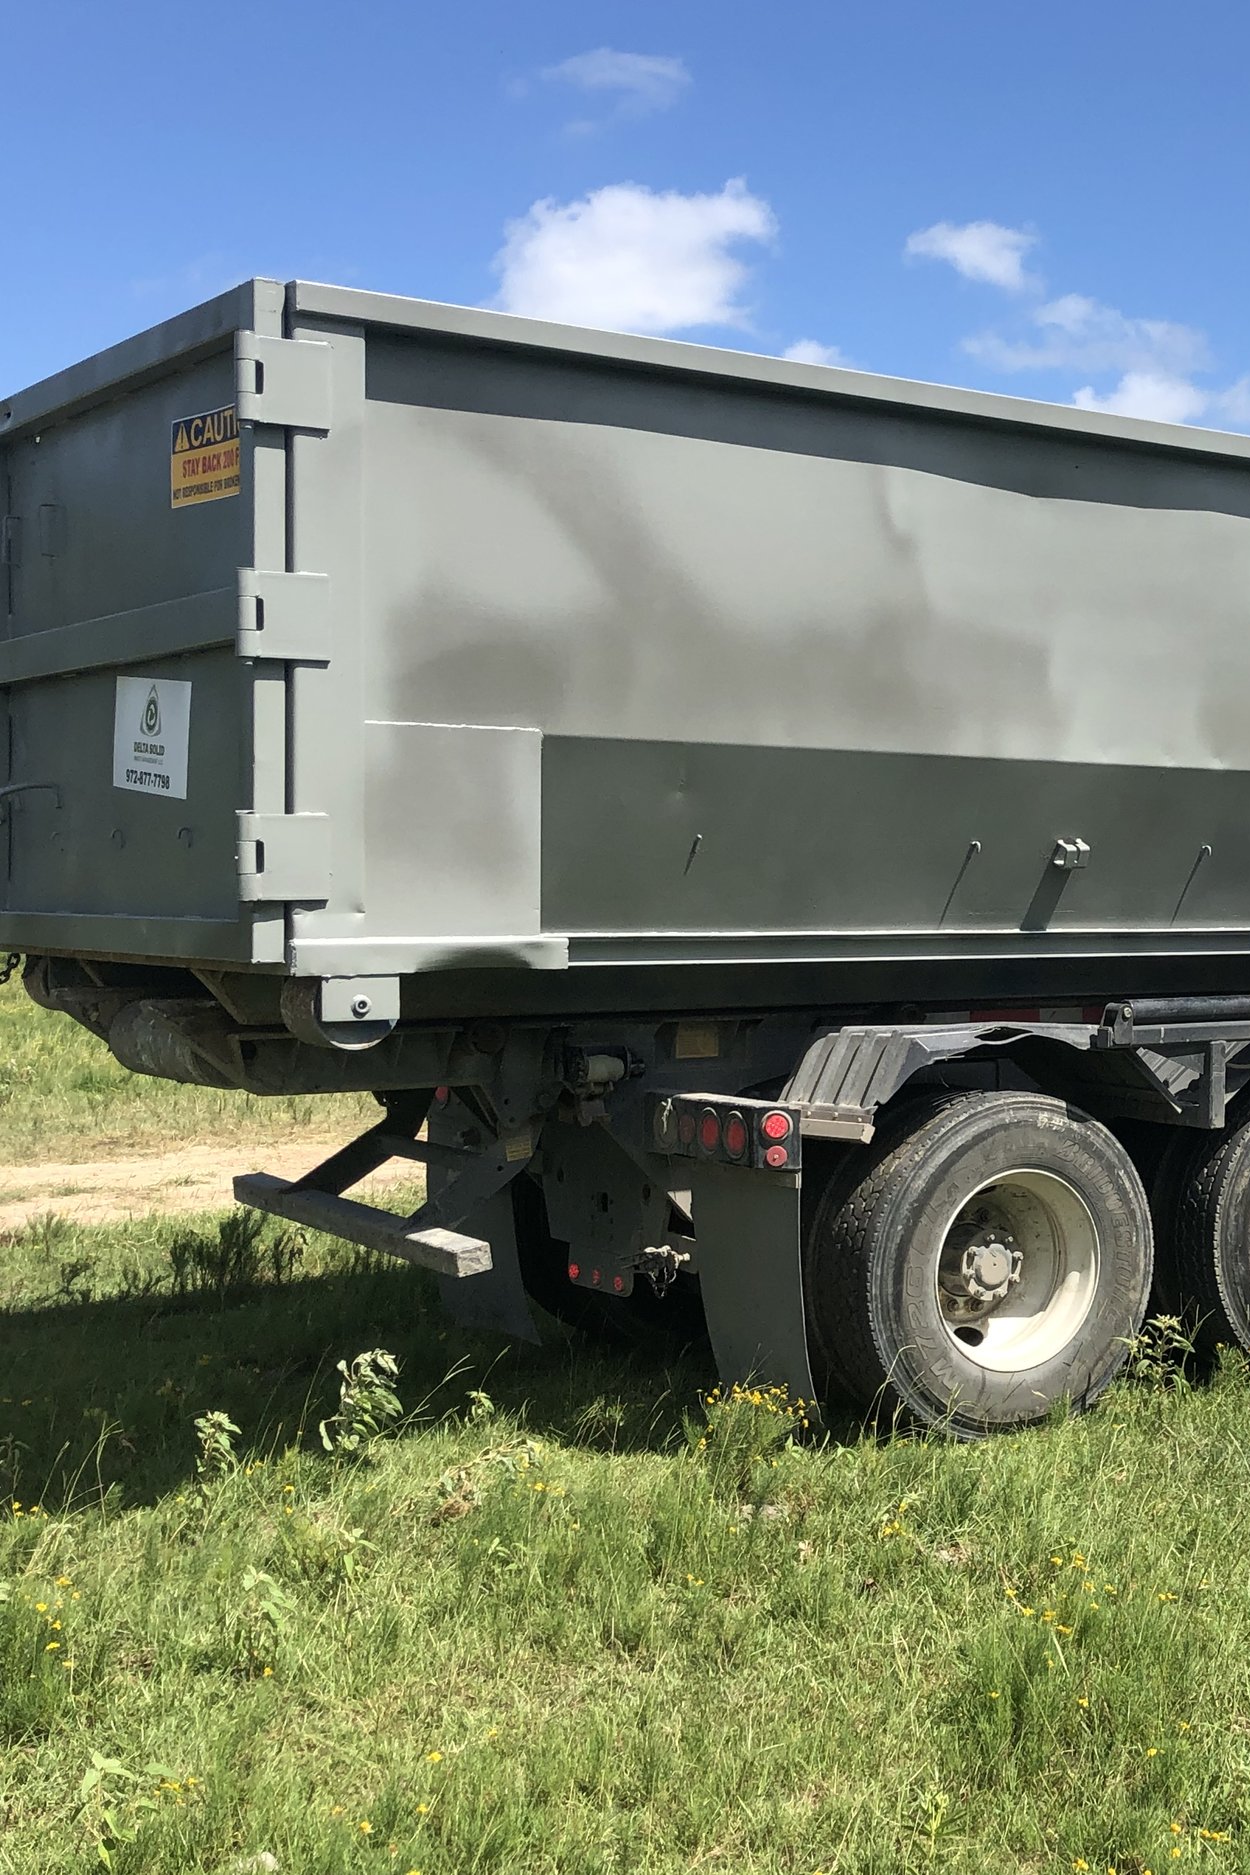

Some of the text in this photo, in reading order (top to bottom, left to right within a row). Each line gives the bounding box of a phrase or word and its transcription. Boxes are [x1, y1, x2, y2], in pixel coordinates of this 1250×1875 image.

[190, 409, 240, 447] CAUTI
[182, 457, 200, 479] STAY
[202, 453, 221, 475] BACK
[133, 741, 165, 757] DELTA SOLID
[125, 768, 170, 790] 972-877-7798
